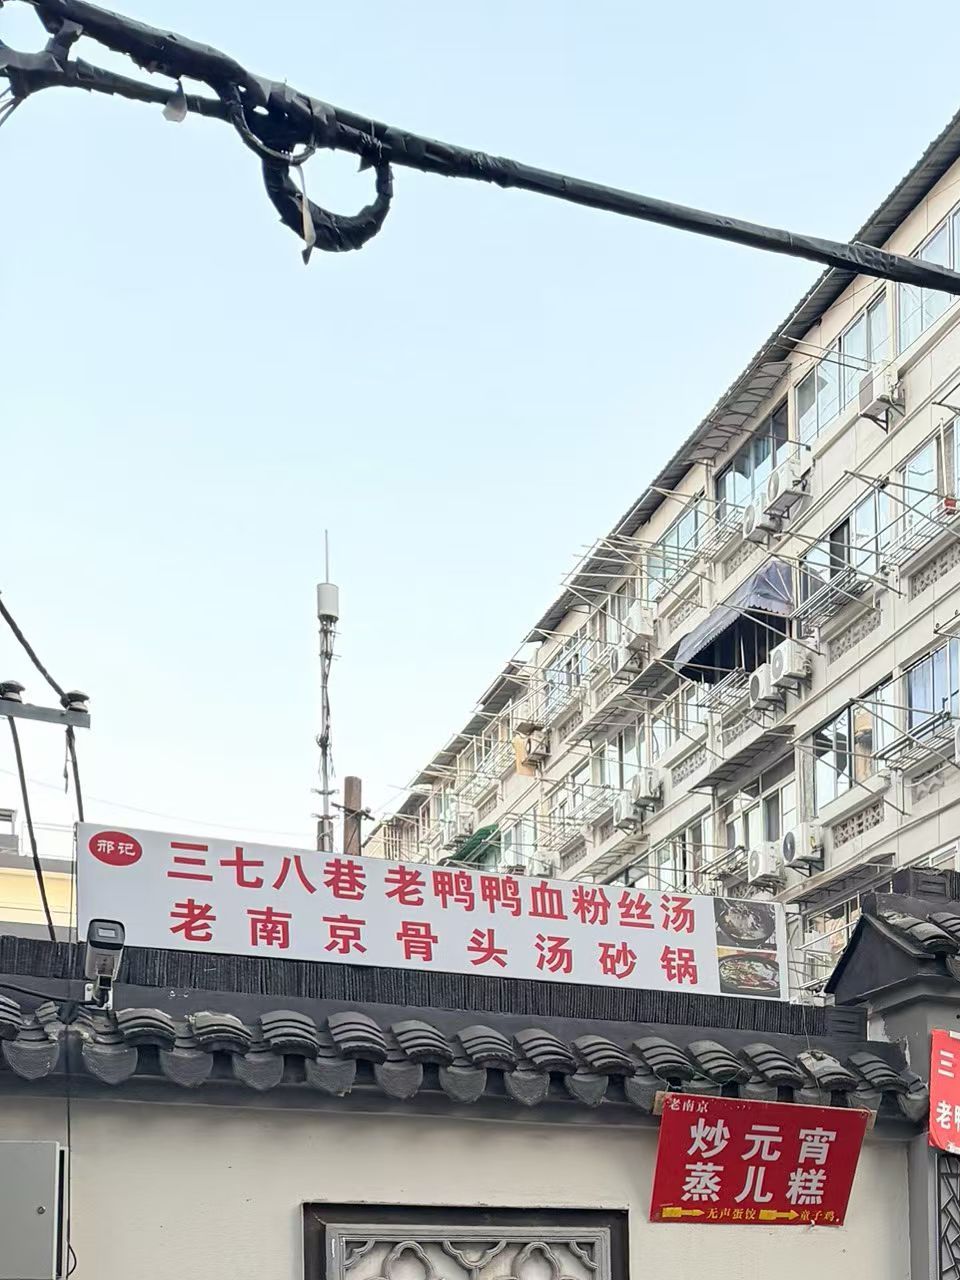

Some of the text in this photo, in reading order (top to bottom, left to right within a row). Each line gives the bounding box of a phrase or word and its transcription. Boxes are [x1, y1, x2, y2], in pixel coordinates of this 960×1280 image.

[97, 839, 136, 857] 邢记
[167, 841, 696, 934] 三七八巷老鸭鸭血粉丝汤
[169, 898, 699, 985] 老南京骨头汤砂锅
[668, 1098, 709, 1114] 老南京
[687, 1117, 837, 1166] 炒元宵
[681, 1162, 827, 1205] 蒸儿糕
[706, 1207, 758, 1221] 无声蛋饺
